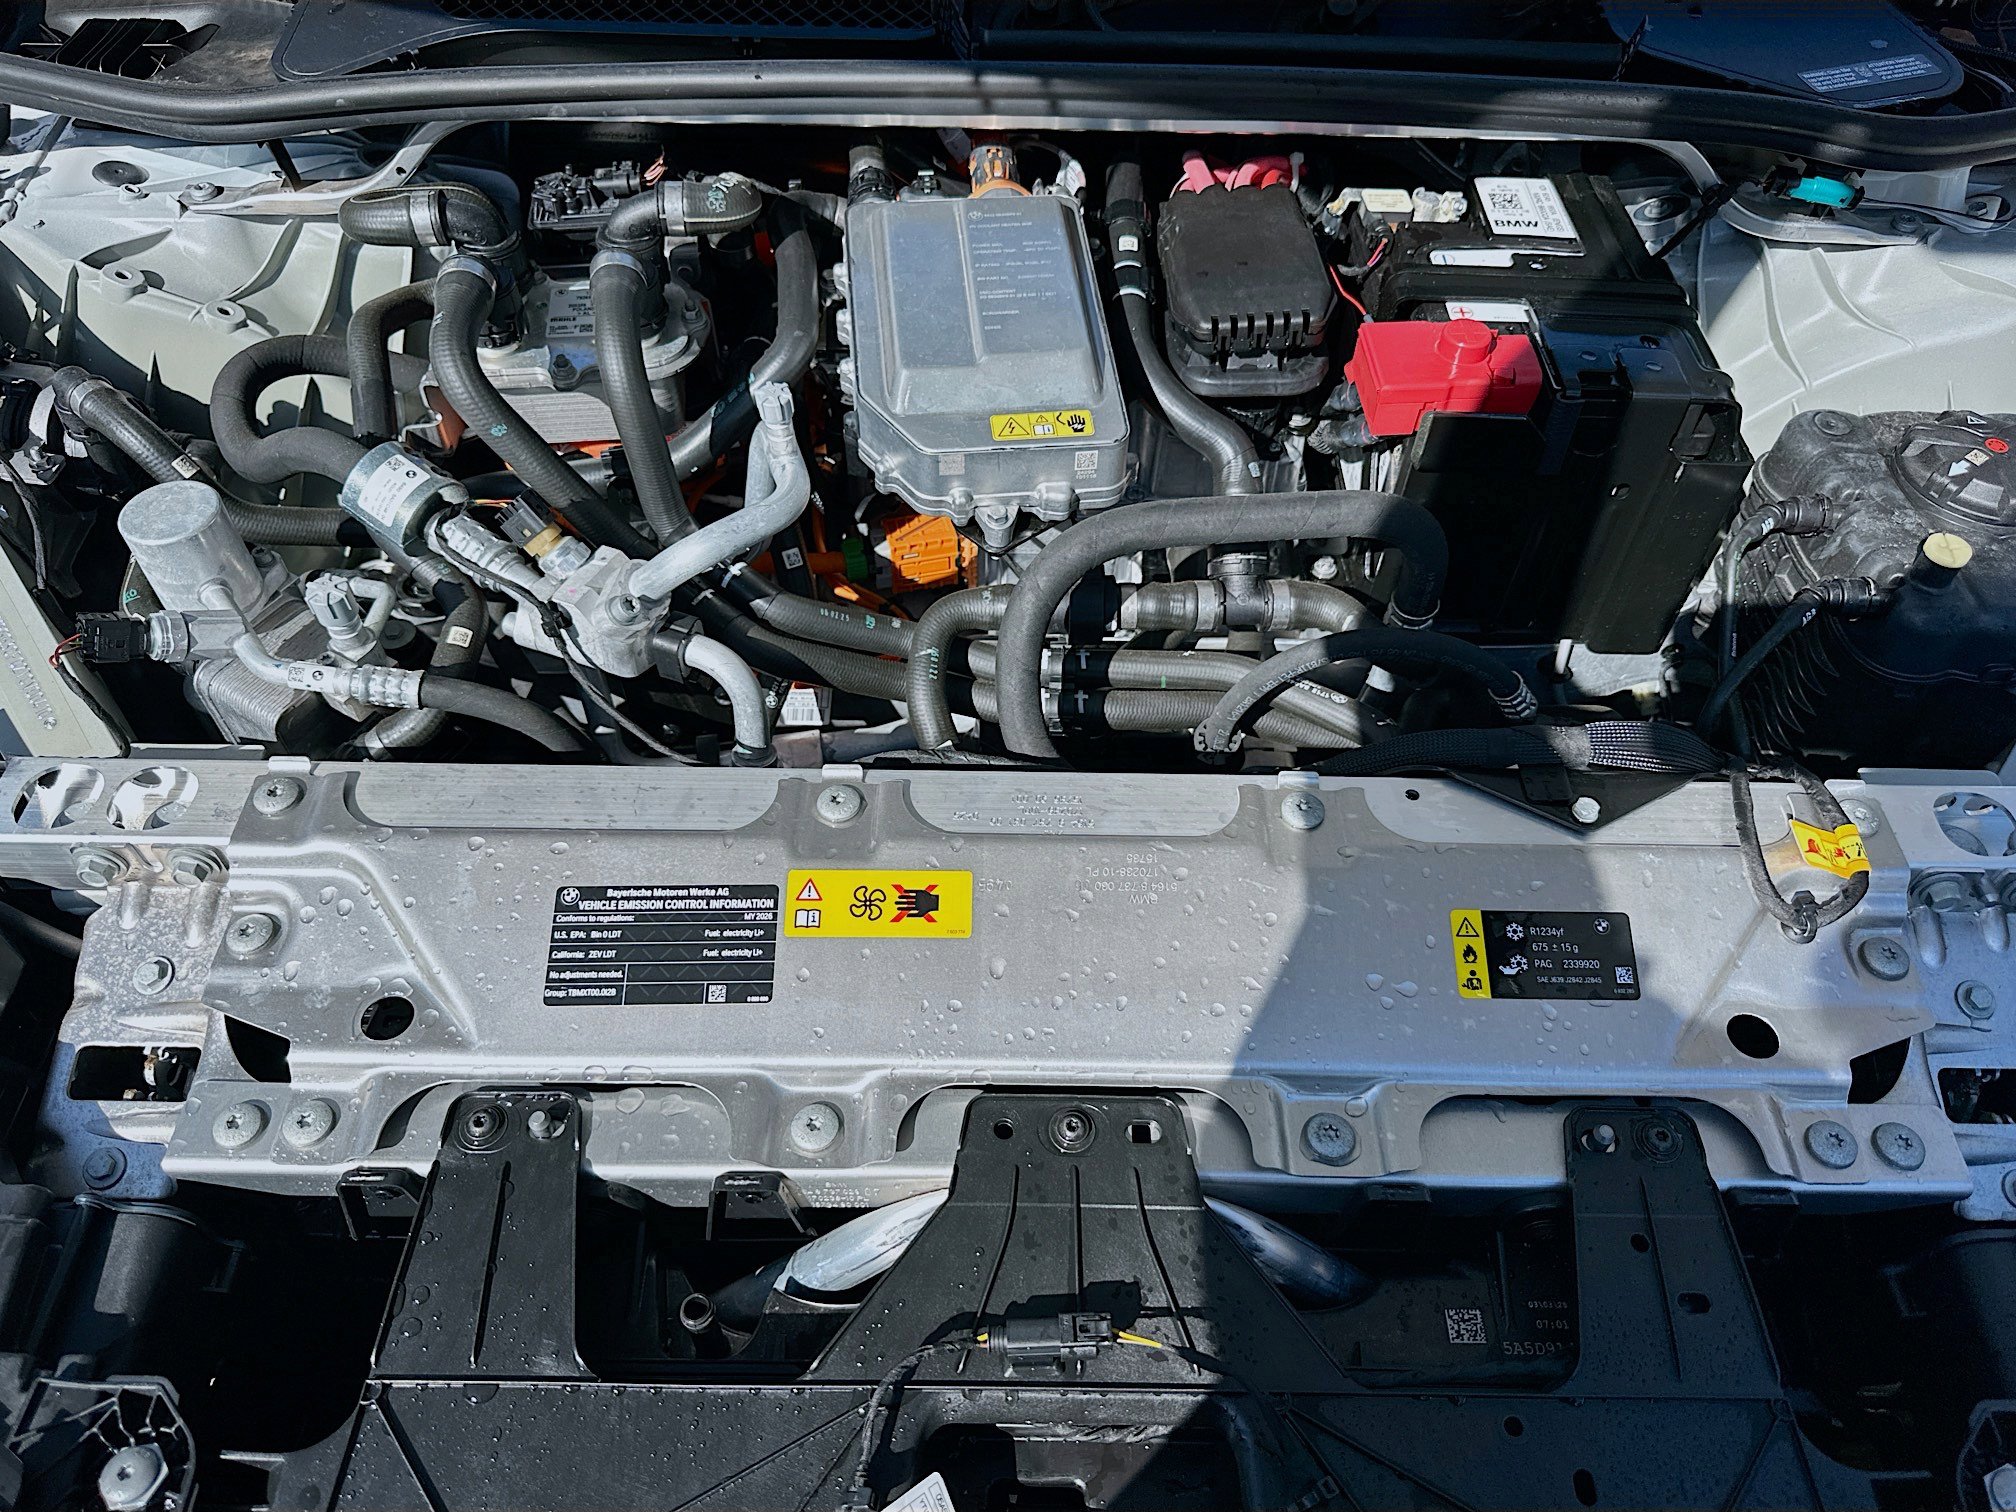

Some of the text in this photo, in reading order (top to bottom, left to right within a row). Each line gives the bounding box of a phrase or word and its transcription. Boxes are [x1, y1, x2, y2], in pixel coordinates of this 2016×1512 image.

[1494, 220, 1538, 228] BMW
[1118, 881, 1136, 891] 737
[1141, 881, 1147, 891] 8
[1151, 881, 1177, 891] 5164
[607, 888, 729, 899] Bayerische Motoren Werke AG
[578, 899, 774, 910] VEHICLE EMISSION CONTROL INFORMATION
[597, 914, 635, 923] regulations:
[554, 931, 568, 939] U.S.
[608, 930, 622, 938] LDT
[704, 929, 720, 937] Fuel:
[722, 929, 754, 938] electricity
[1530, 927, 1564, 937] R1234yf
[1532, 943, 1549, 951] 675
[1560, 943, 1571, 951] 15
[1572, 945, 1578, 953] g
[552, 950, 617, 959] California: ZEV LDT
[702, 949, 719, 957] Fuel:
[721, 949, 753, 958] electricity
[1534, 960, 1600, 969] PAG 2339920
[549, 970, 623, 979] No adjustments needed.
[544, 989, 567, 998] Group:
[1536, 1319, 1570, 1330] 07:01
